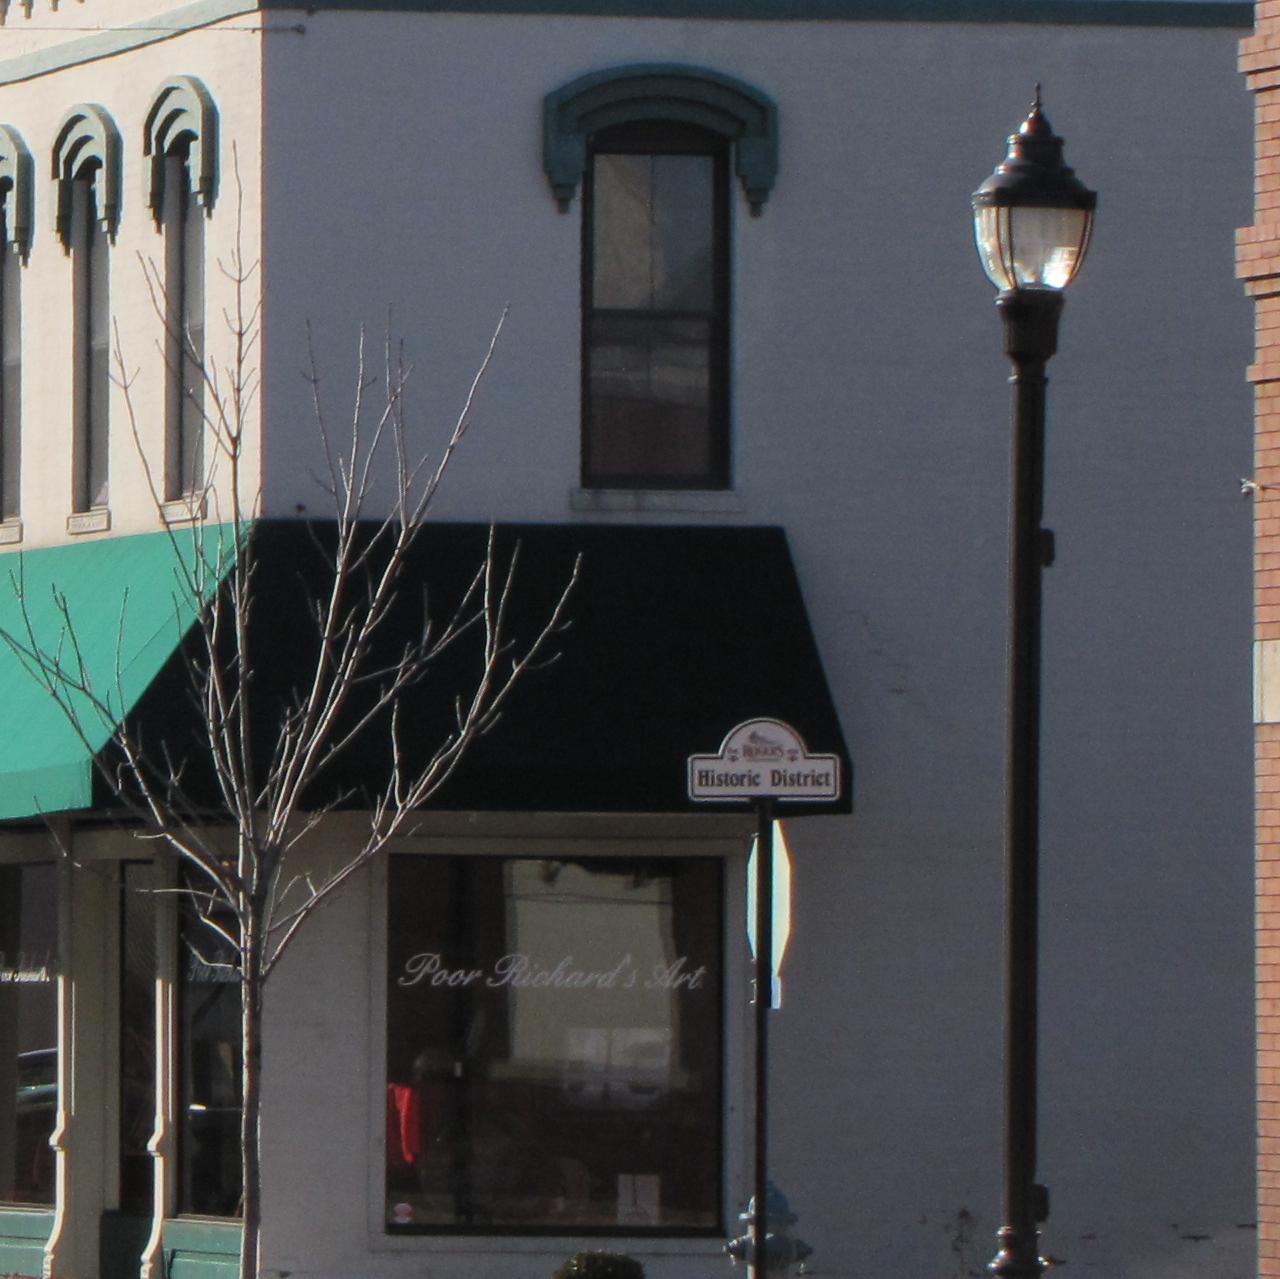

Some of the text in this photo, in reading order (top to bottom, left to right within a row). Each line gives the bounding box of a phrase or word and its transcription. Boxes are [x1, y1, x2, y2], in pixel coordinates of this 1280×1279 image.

[697, 768, 831, 788] Historic District
[397, 952, 708, 990] Poor Richard's Art
